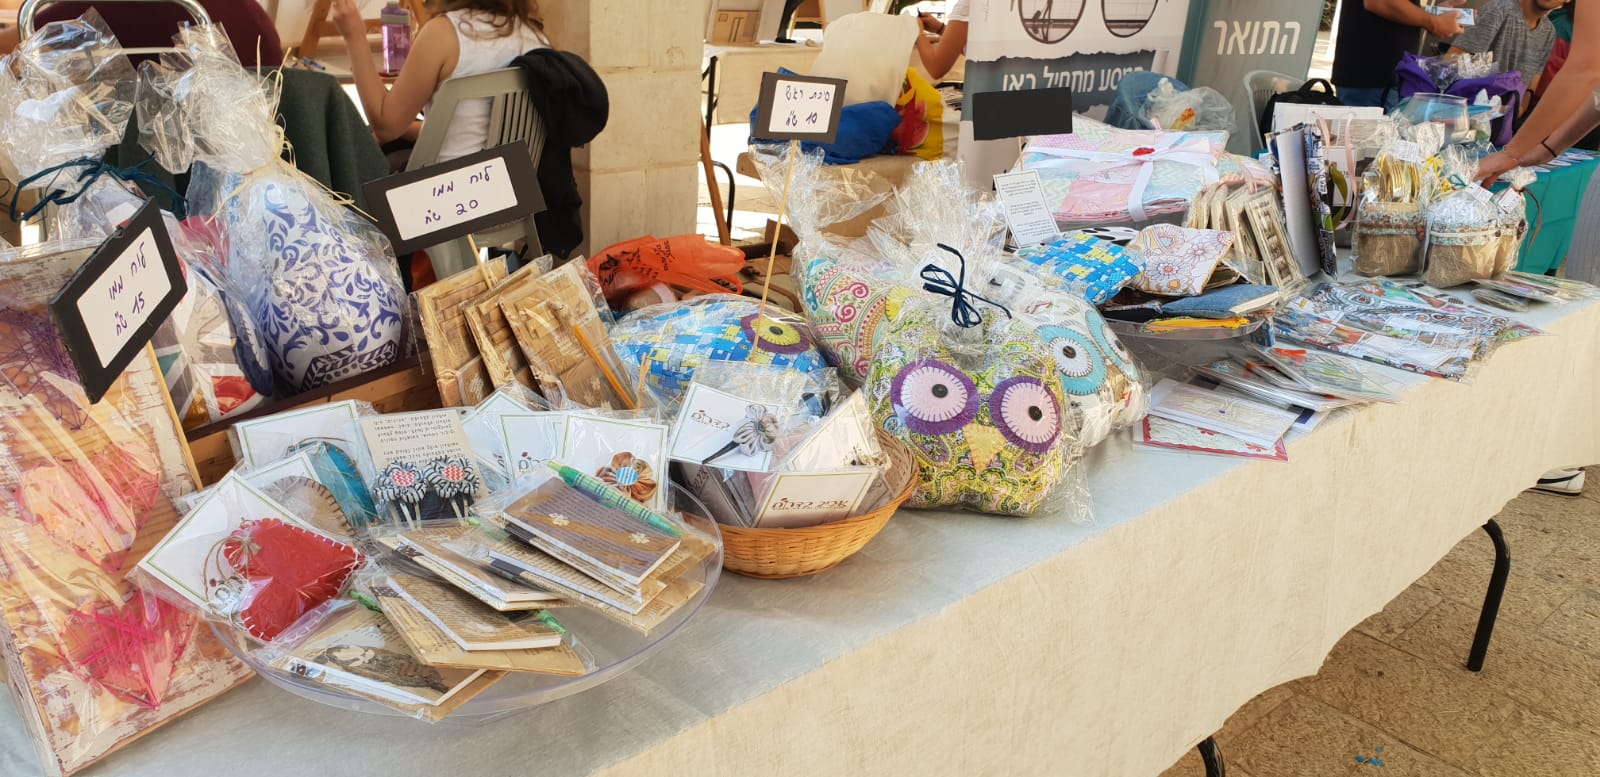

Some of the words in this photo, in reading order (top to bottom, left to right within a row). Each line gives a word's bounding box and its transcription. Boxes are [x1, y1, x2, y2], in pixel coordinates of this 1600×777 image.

[1214, 20, 1300, 55] התואר
[1043, 65, 1095, 93] מתחיל
[805, 111, 818, 125] 10
[470, 165, 493, 184] לוח
[432, 180, 454, 197] ממו
[455, 199, 479, 216] 20
[130, 241, 147, 277] לוח
[108, 274, 124, 301] ממו
[132, 291, 146, 314] 15
